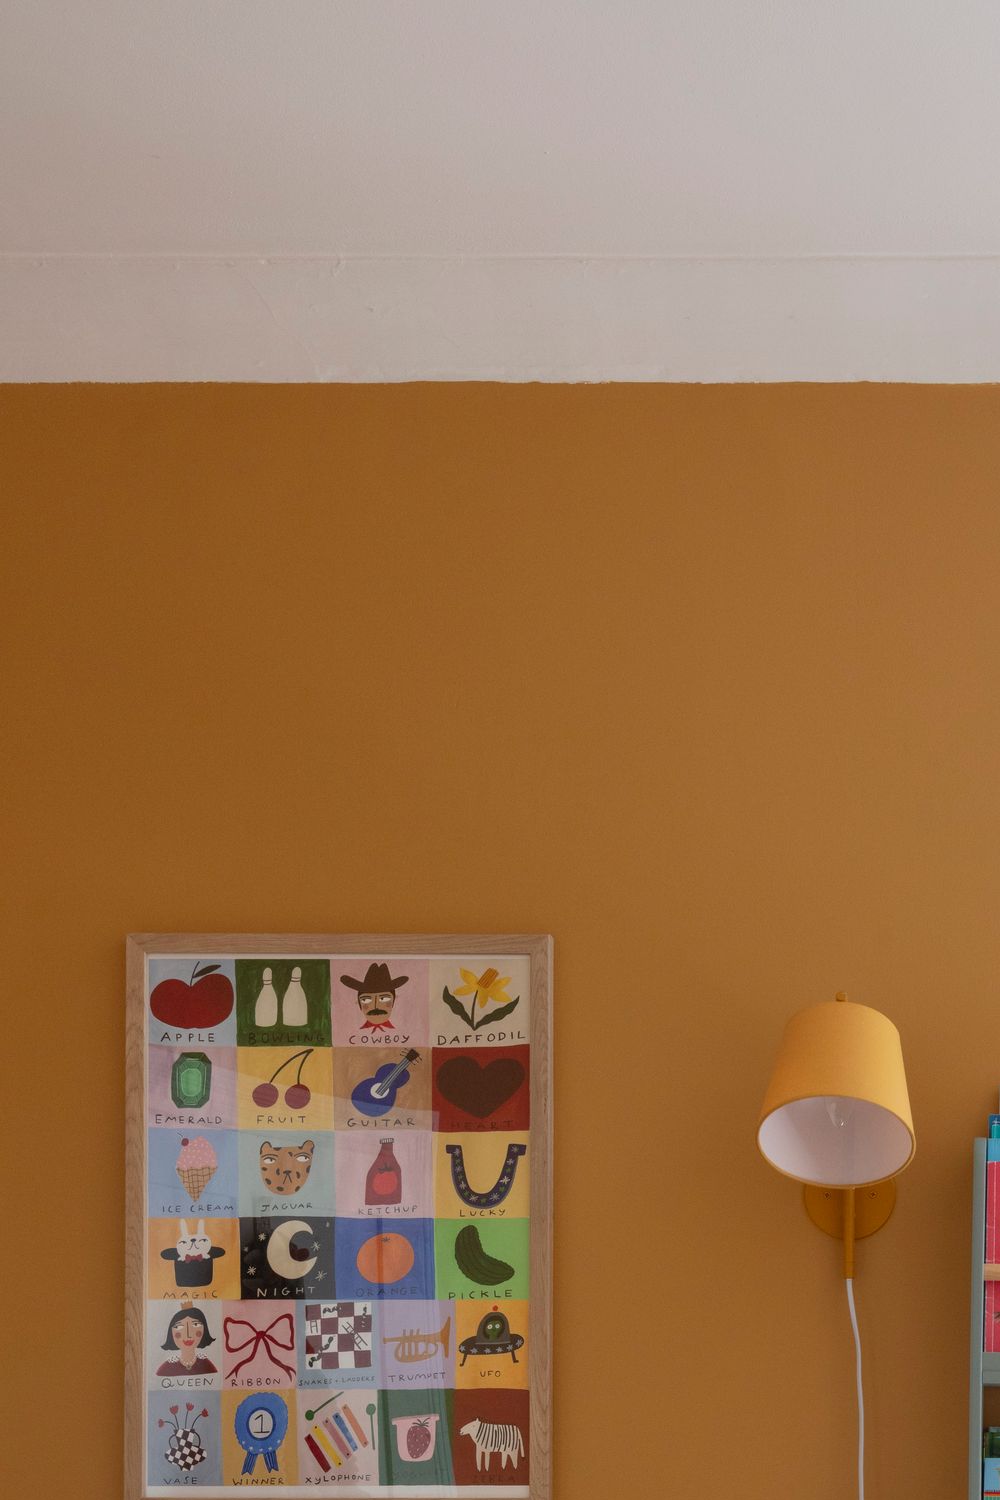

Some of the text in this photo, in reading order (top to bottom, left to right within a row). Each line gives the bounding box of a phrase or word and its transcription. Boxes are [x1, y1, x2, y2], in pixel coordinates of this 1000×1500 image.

[160, 1032, 215, 1043] APPLE
[248, 1032, 325, 1044] BOWLING
[349, 1033, 410, 1045] COWBOY
[437, 1030, 526, 1045] DAFFODIL
[154, 1114, 222, 1126] EMERALD
[256, 1114, 306, 1125] FRUIT
[347, 1117, 416, 1128] GUITAR
[450, 1119, 514, 1130] HEART
[162, 1204, 234, 1213] ICE CREAM
[261, 1202, 313, 1212] JAGUAR
[357, 1204, 418, 1217] KETCHUP
[459, 1208, 506, 1218] LUCKY
[163, 1290, 218, 1299] MAGIC
[256, 1285, 316, 1297] NIGHT
[356, 1287, 418, 1297] ORANGE
[449, 1289, 513, 1300] PICKLE
[388, 1371, 446, 1382] TRUMPET
[479, 1368, 501, 1379] UFO
[161, 1377, 214, 1388] QUEEN
[231, 1376, 281, 1387] RIBBON
[298, 1378, 332, 1386] SNAKES
[253, 1414, 270, 1434] 1
[163, 1476, 199, 1486] VASE
[233, 1476, 285, 1486] WINNER
[305, 1474, 371, 1484] XYLOPHONE
